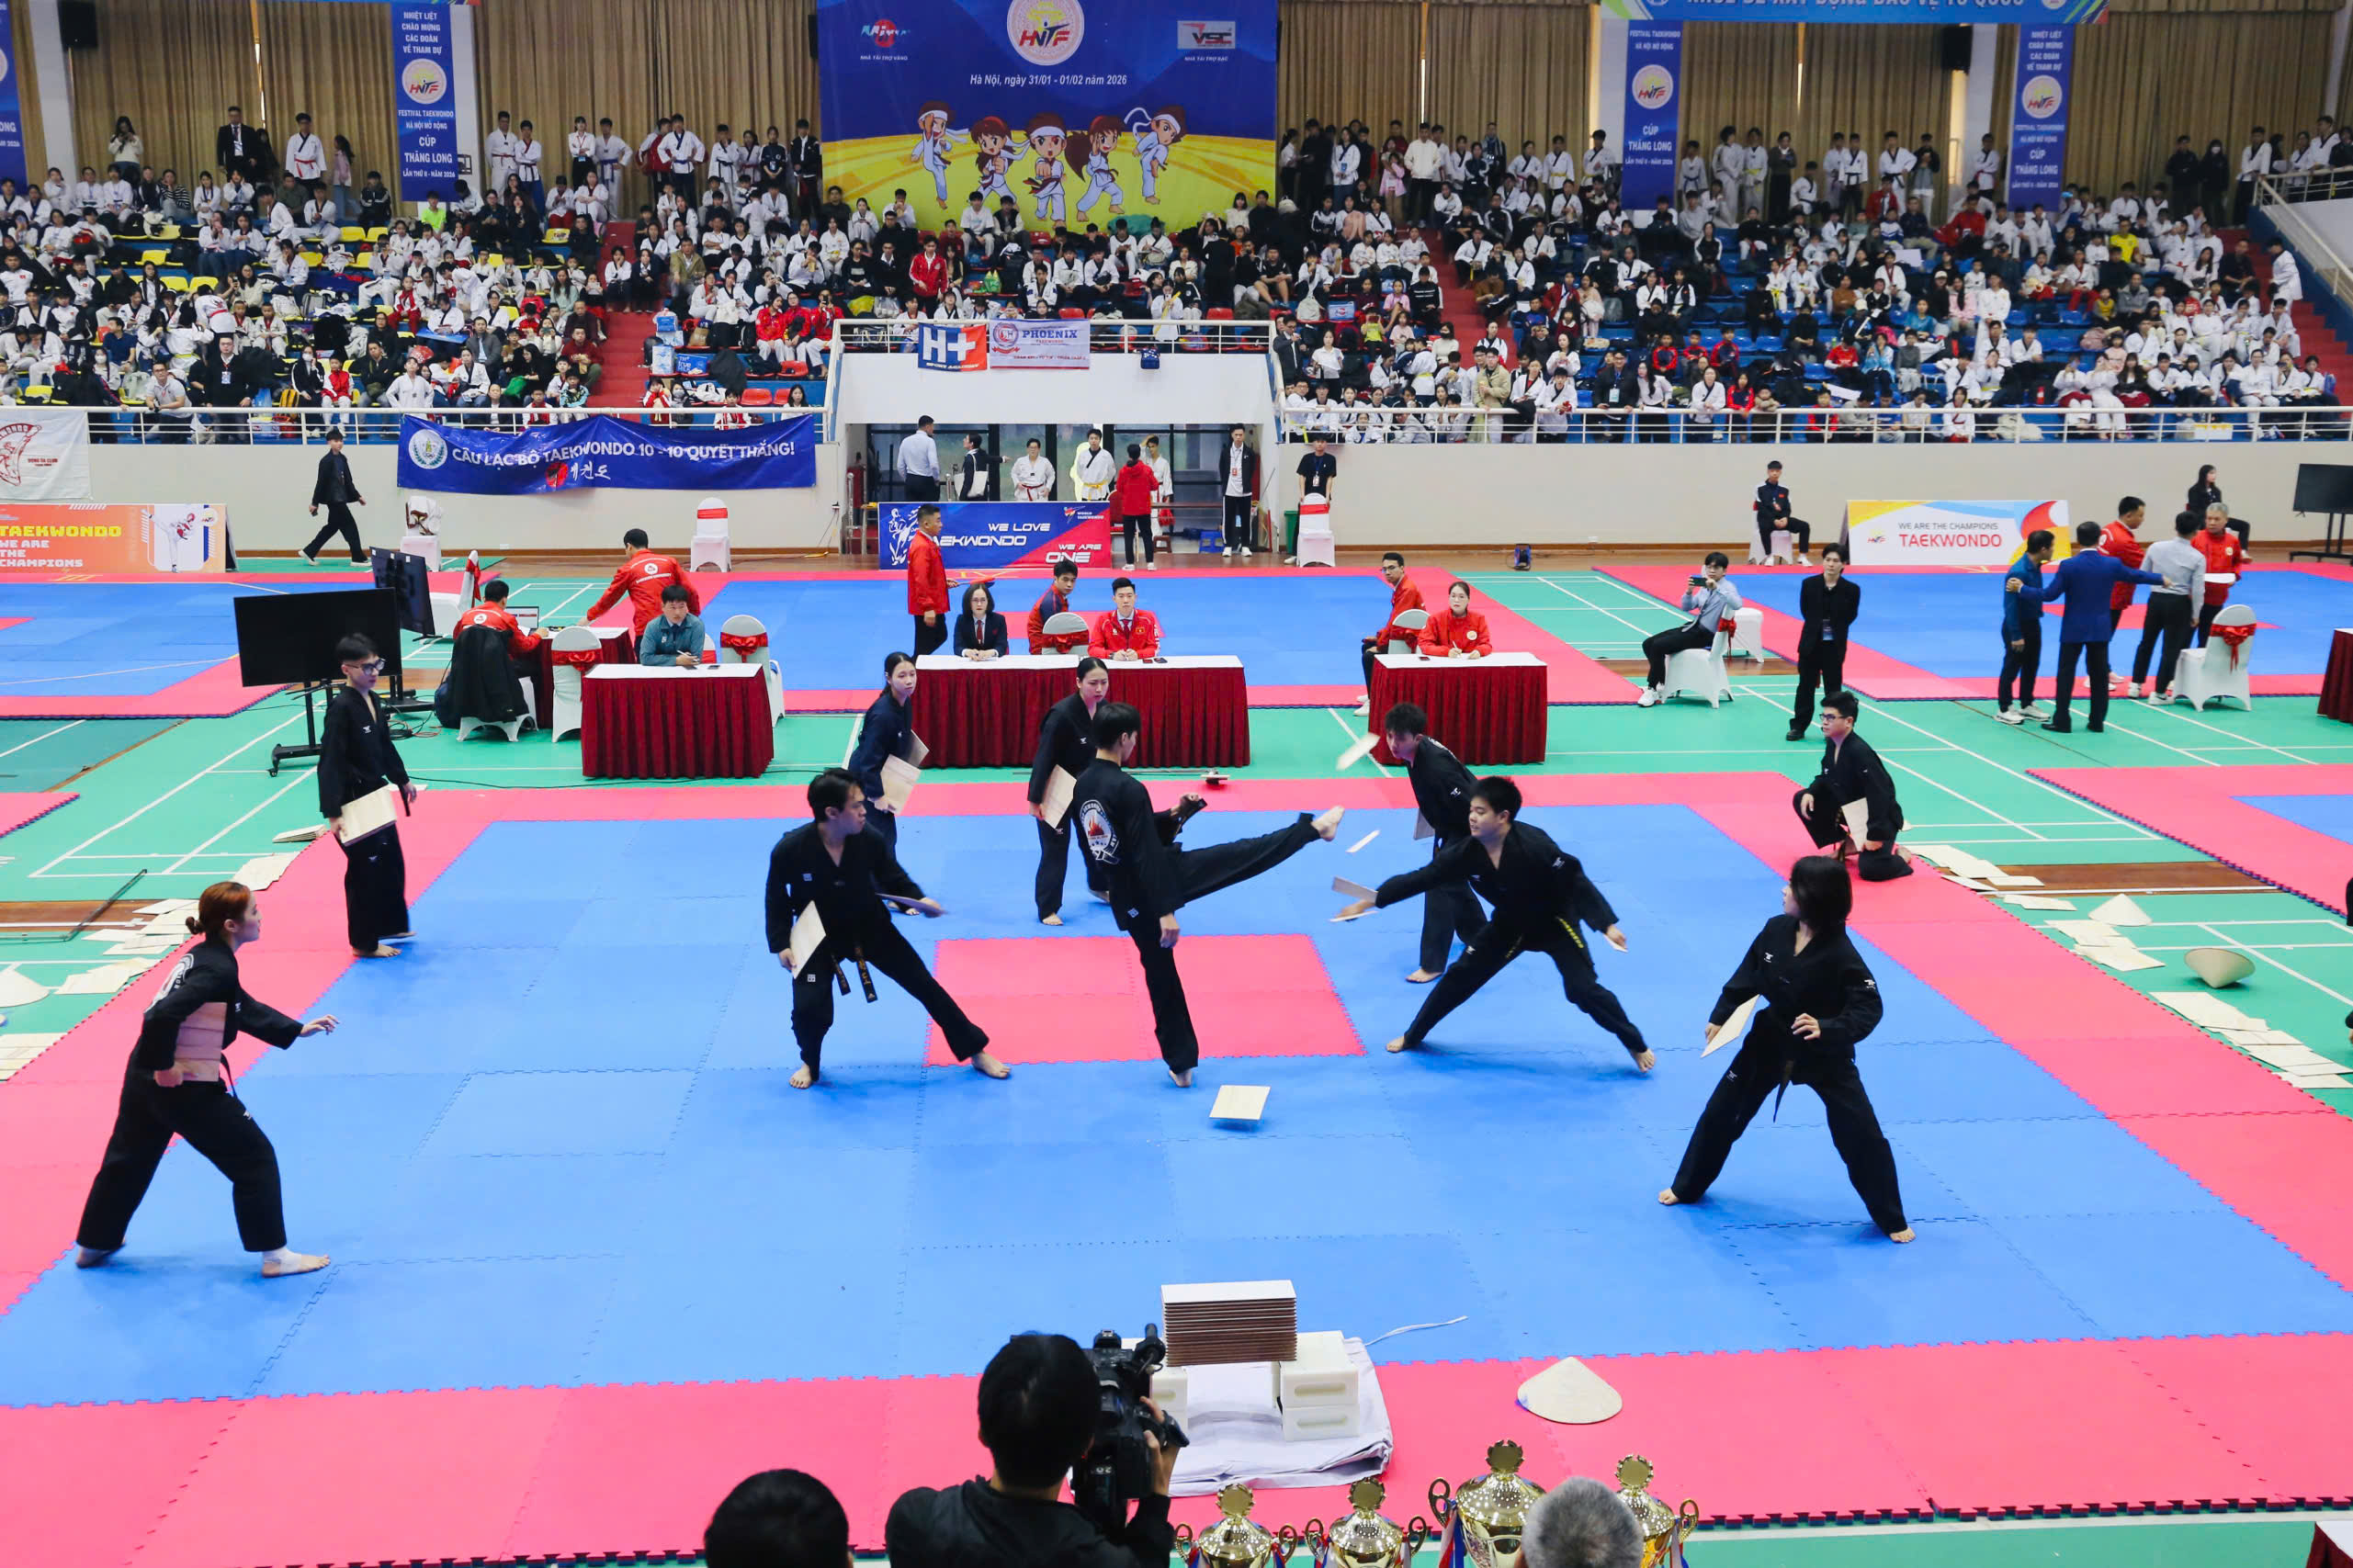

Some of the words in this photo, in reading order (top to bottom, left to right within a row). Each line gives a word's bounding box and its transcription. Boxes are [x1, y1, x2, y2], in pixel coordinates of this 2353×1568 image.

[403, 11, 422, 21] NHIỆT
[424, 12, 437, 21] LIỆT
[402, 22, 419, 30] CHÀO
[405, 33, 419, 42] CÁC
[1192, 31, 1232, 45] VSC
[413, 45, 431, 53] THAM
[970, 74, 982, 85] Hà
[985, 74, 1001, 87] Nội,
[1004, 75, 1026, 87] ngày
[1028, 74, 1052, 85] 31/01
[1059, 74, 1083, 85] 01/02
[1085, 73, 1104, 85] năm
[1106, 74, 1127, 85] 2026
[423, 109, 454, 118] TAEKWONDO
[1642, 123, 1659, 135] CÚP
[419, 134, 436, 147] CÚP
[1653, 141, 1672, 152] LONG
[404, 150, 430, 163] THĂNG
[432, 153, 453, 164] LONG
[2039, 164, 2058, 175] LONG
[1022, 330, 1078, 339] PHOENIX
[452, 447, 481, 465] CÂU
[484, 453, 515, 470] LẠC
[517, 449, 540, 468] BỘ
[544, 441, 635, 463] TAEKWONDO
[639, 443, 654, 457] 10
[667, 446, 683, 458] 10
[0, 525, 122, 537] TAEKWONDO
[988, 523, 1009, 532] WE
[1012, 523, 1051, 532] LOVE
[0, 540, 18, 548] WE
[21, 540, 50, 548] ARE
[933, 535, 1027, 547] AEKWONDO
[1899, 534, 2002, 547] TAEKWONDO
[0, 549, 27, 558] THE
[1045, 551, 1092, 563] ONE
